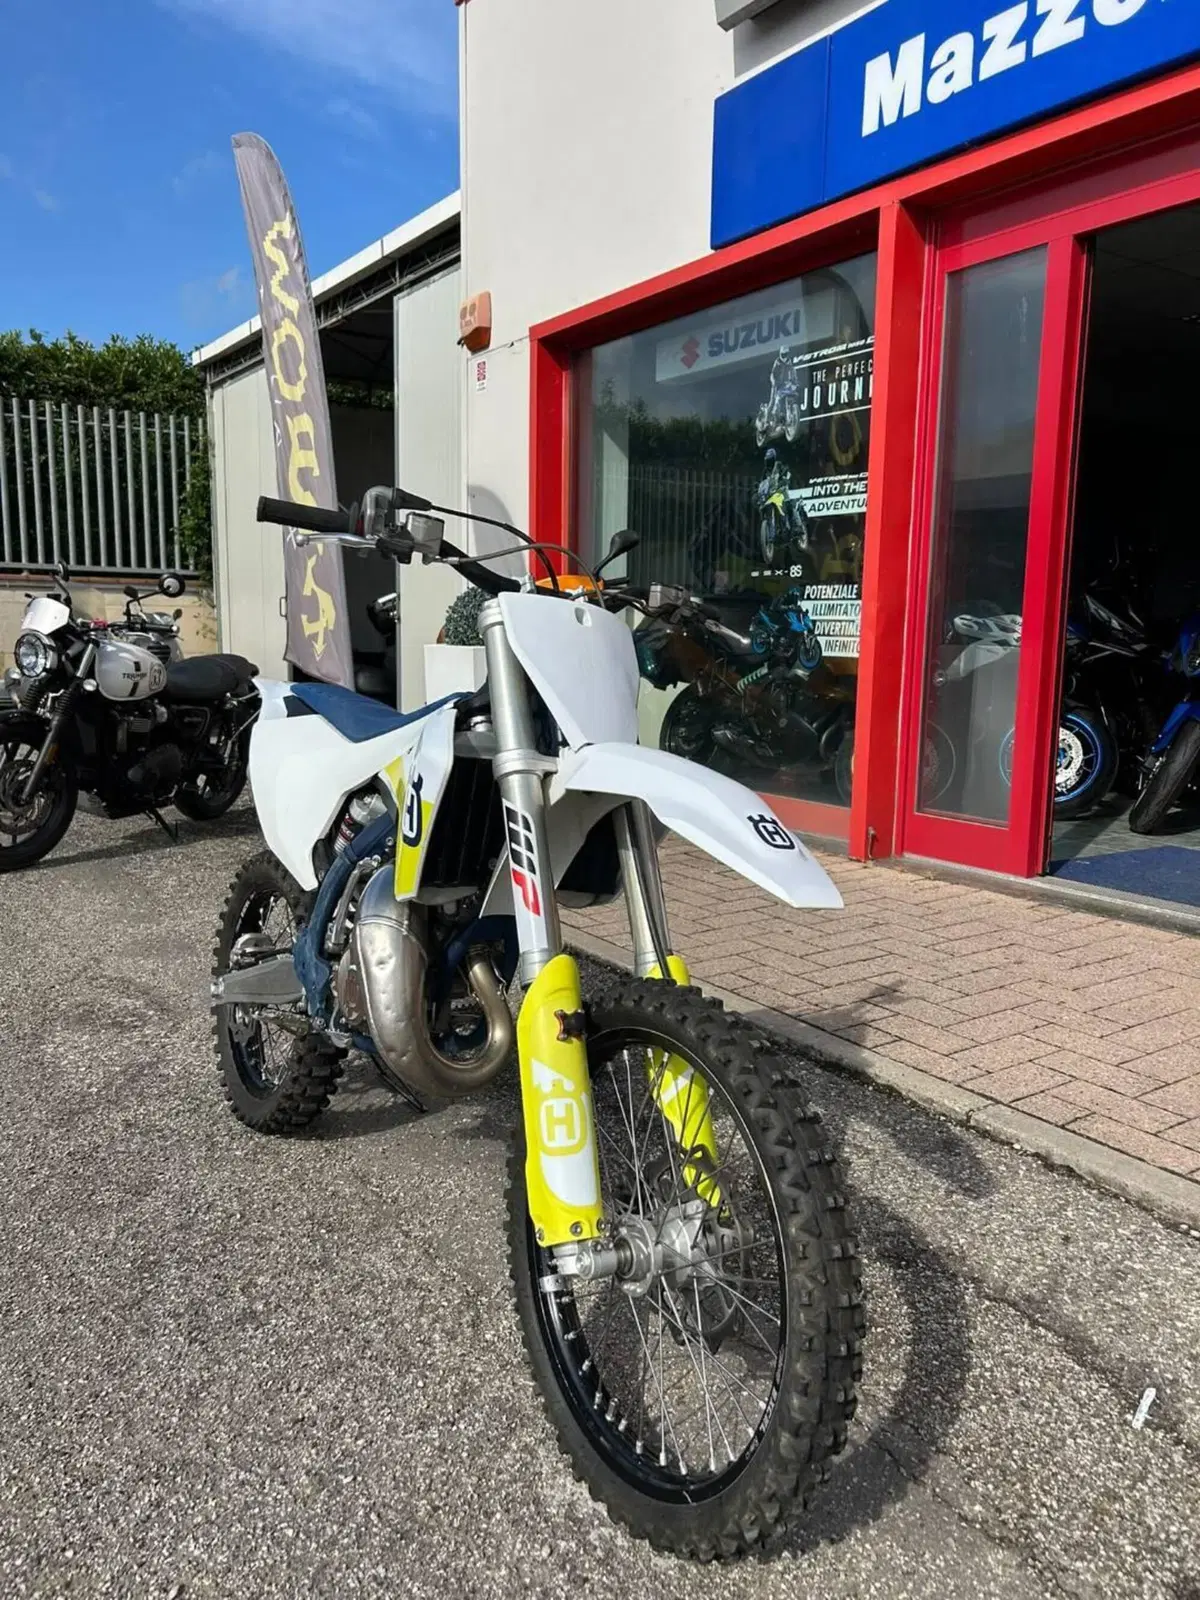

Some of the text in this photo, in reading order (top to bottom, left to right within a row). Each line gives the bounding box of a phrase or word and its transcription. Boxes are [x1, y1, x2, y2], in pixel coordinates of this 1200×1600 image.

[707, 309, 800, 357] SUZUKI
[813, 369, 827, 383] THE
[814, 481, 868, 496] INTO THE
[804, 584, 858, 599] POTENZIALE
